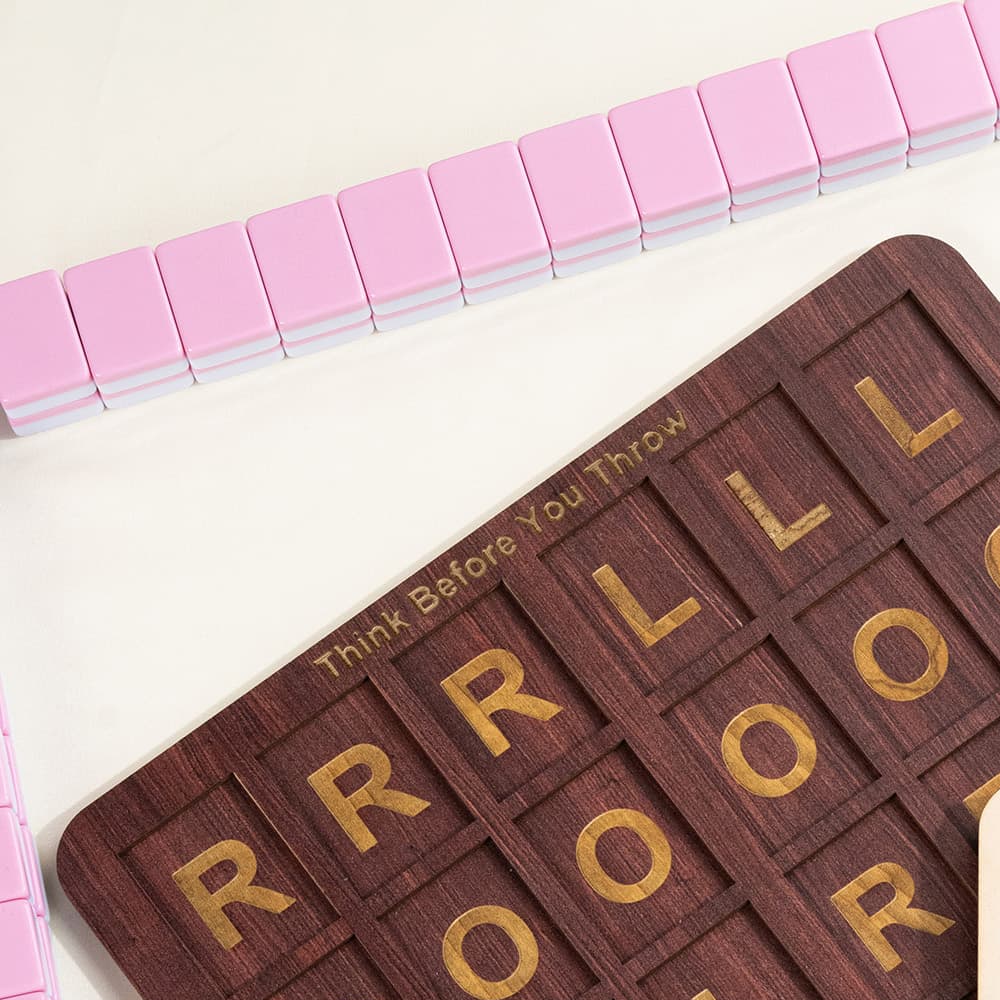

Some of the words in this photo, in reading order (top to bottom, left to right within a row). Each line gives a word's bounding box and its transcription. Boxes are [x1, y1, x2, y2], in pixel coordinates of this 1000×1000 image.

[172, 838, 297, 950] R
[306, 742, 431, 853] R
[440, 648, 563, 758] R
[591, 563, 702, 648] L
[725, 470, 833, 552] L
[855, 376, 963, 458] L
[313, 608, 411, 678] Think
[407, 535, 517, 616] Before
[514, 484, 585, 533] You
[583, 409, 689, 486] Throw
[442, 905, 540, 1000] O
[575, 808, 673, 904] O
[720, 703, 818, 798] O
[852, 607, 950, 702] O
[830, 861, 956, 972] R
